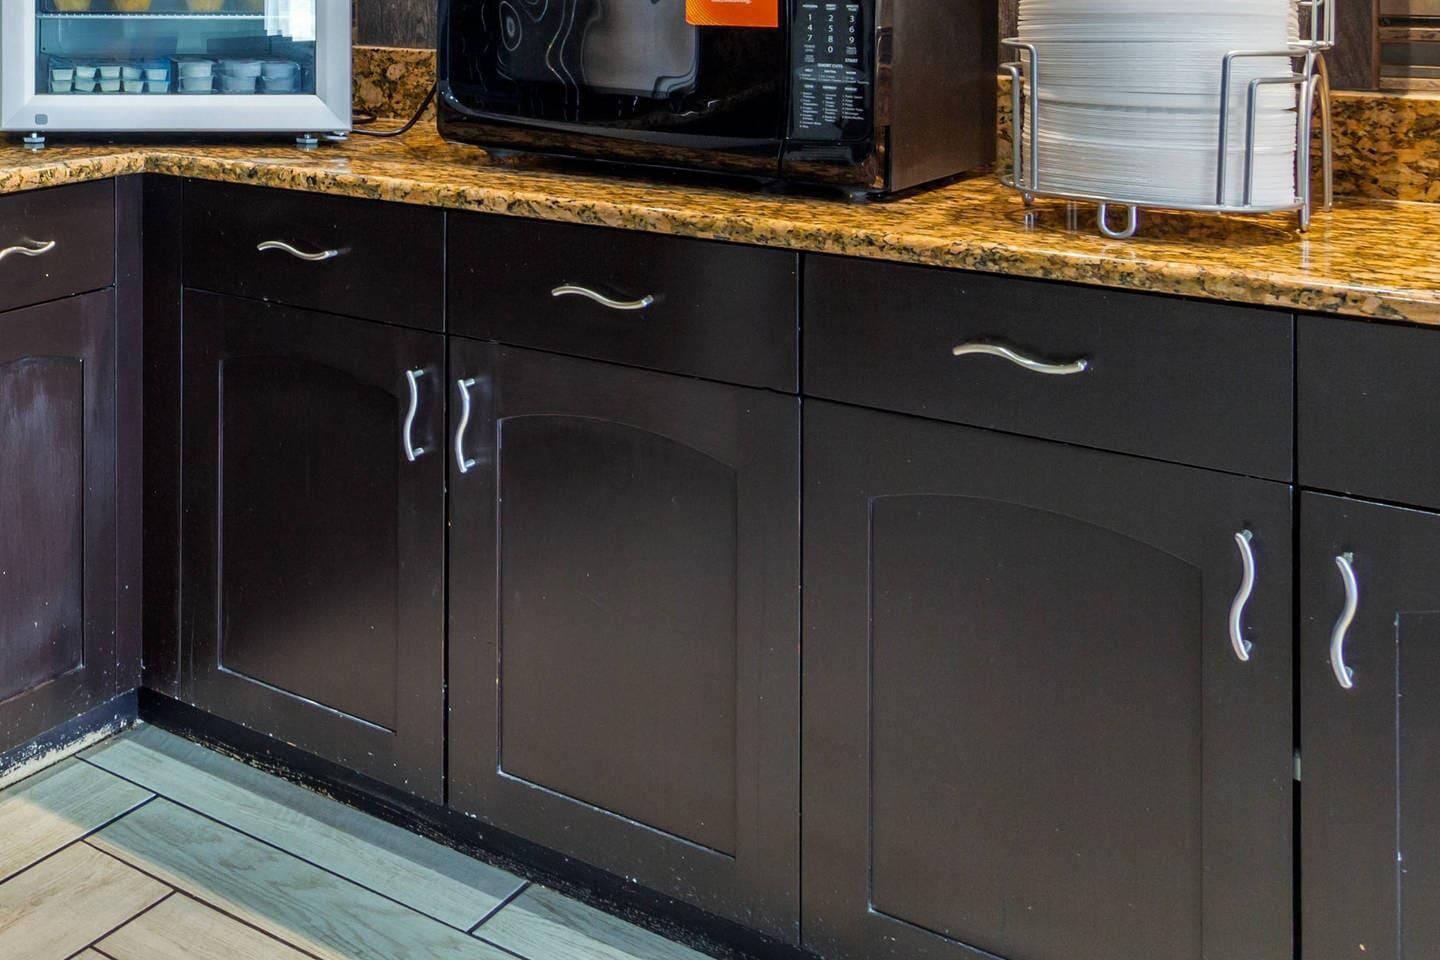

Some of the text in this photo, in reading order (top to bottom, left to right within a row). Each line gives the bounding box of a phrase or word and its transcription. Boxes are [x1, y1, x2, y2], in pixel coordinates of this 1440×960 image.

[828, 14, 834, 22] 2
[849, 15, 855, 23] 3
[828, 25, 833, 33] 5
[828, 35, 834, 43] 8
[848, 36, 855, 44] 9
[827, 45, 833, 53] 0
